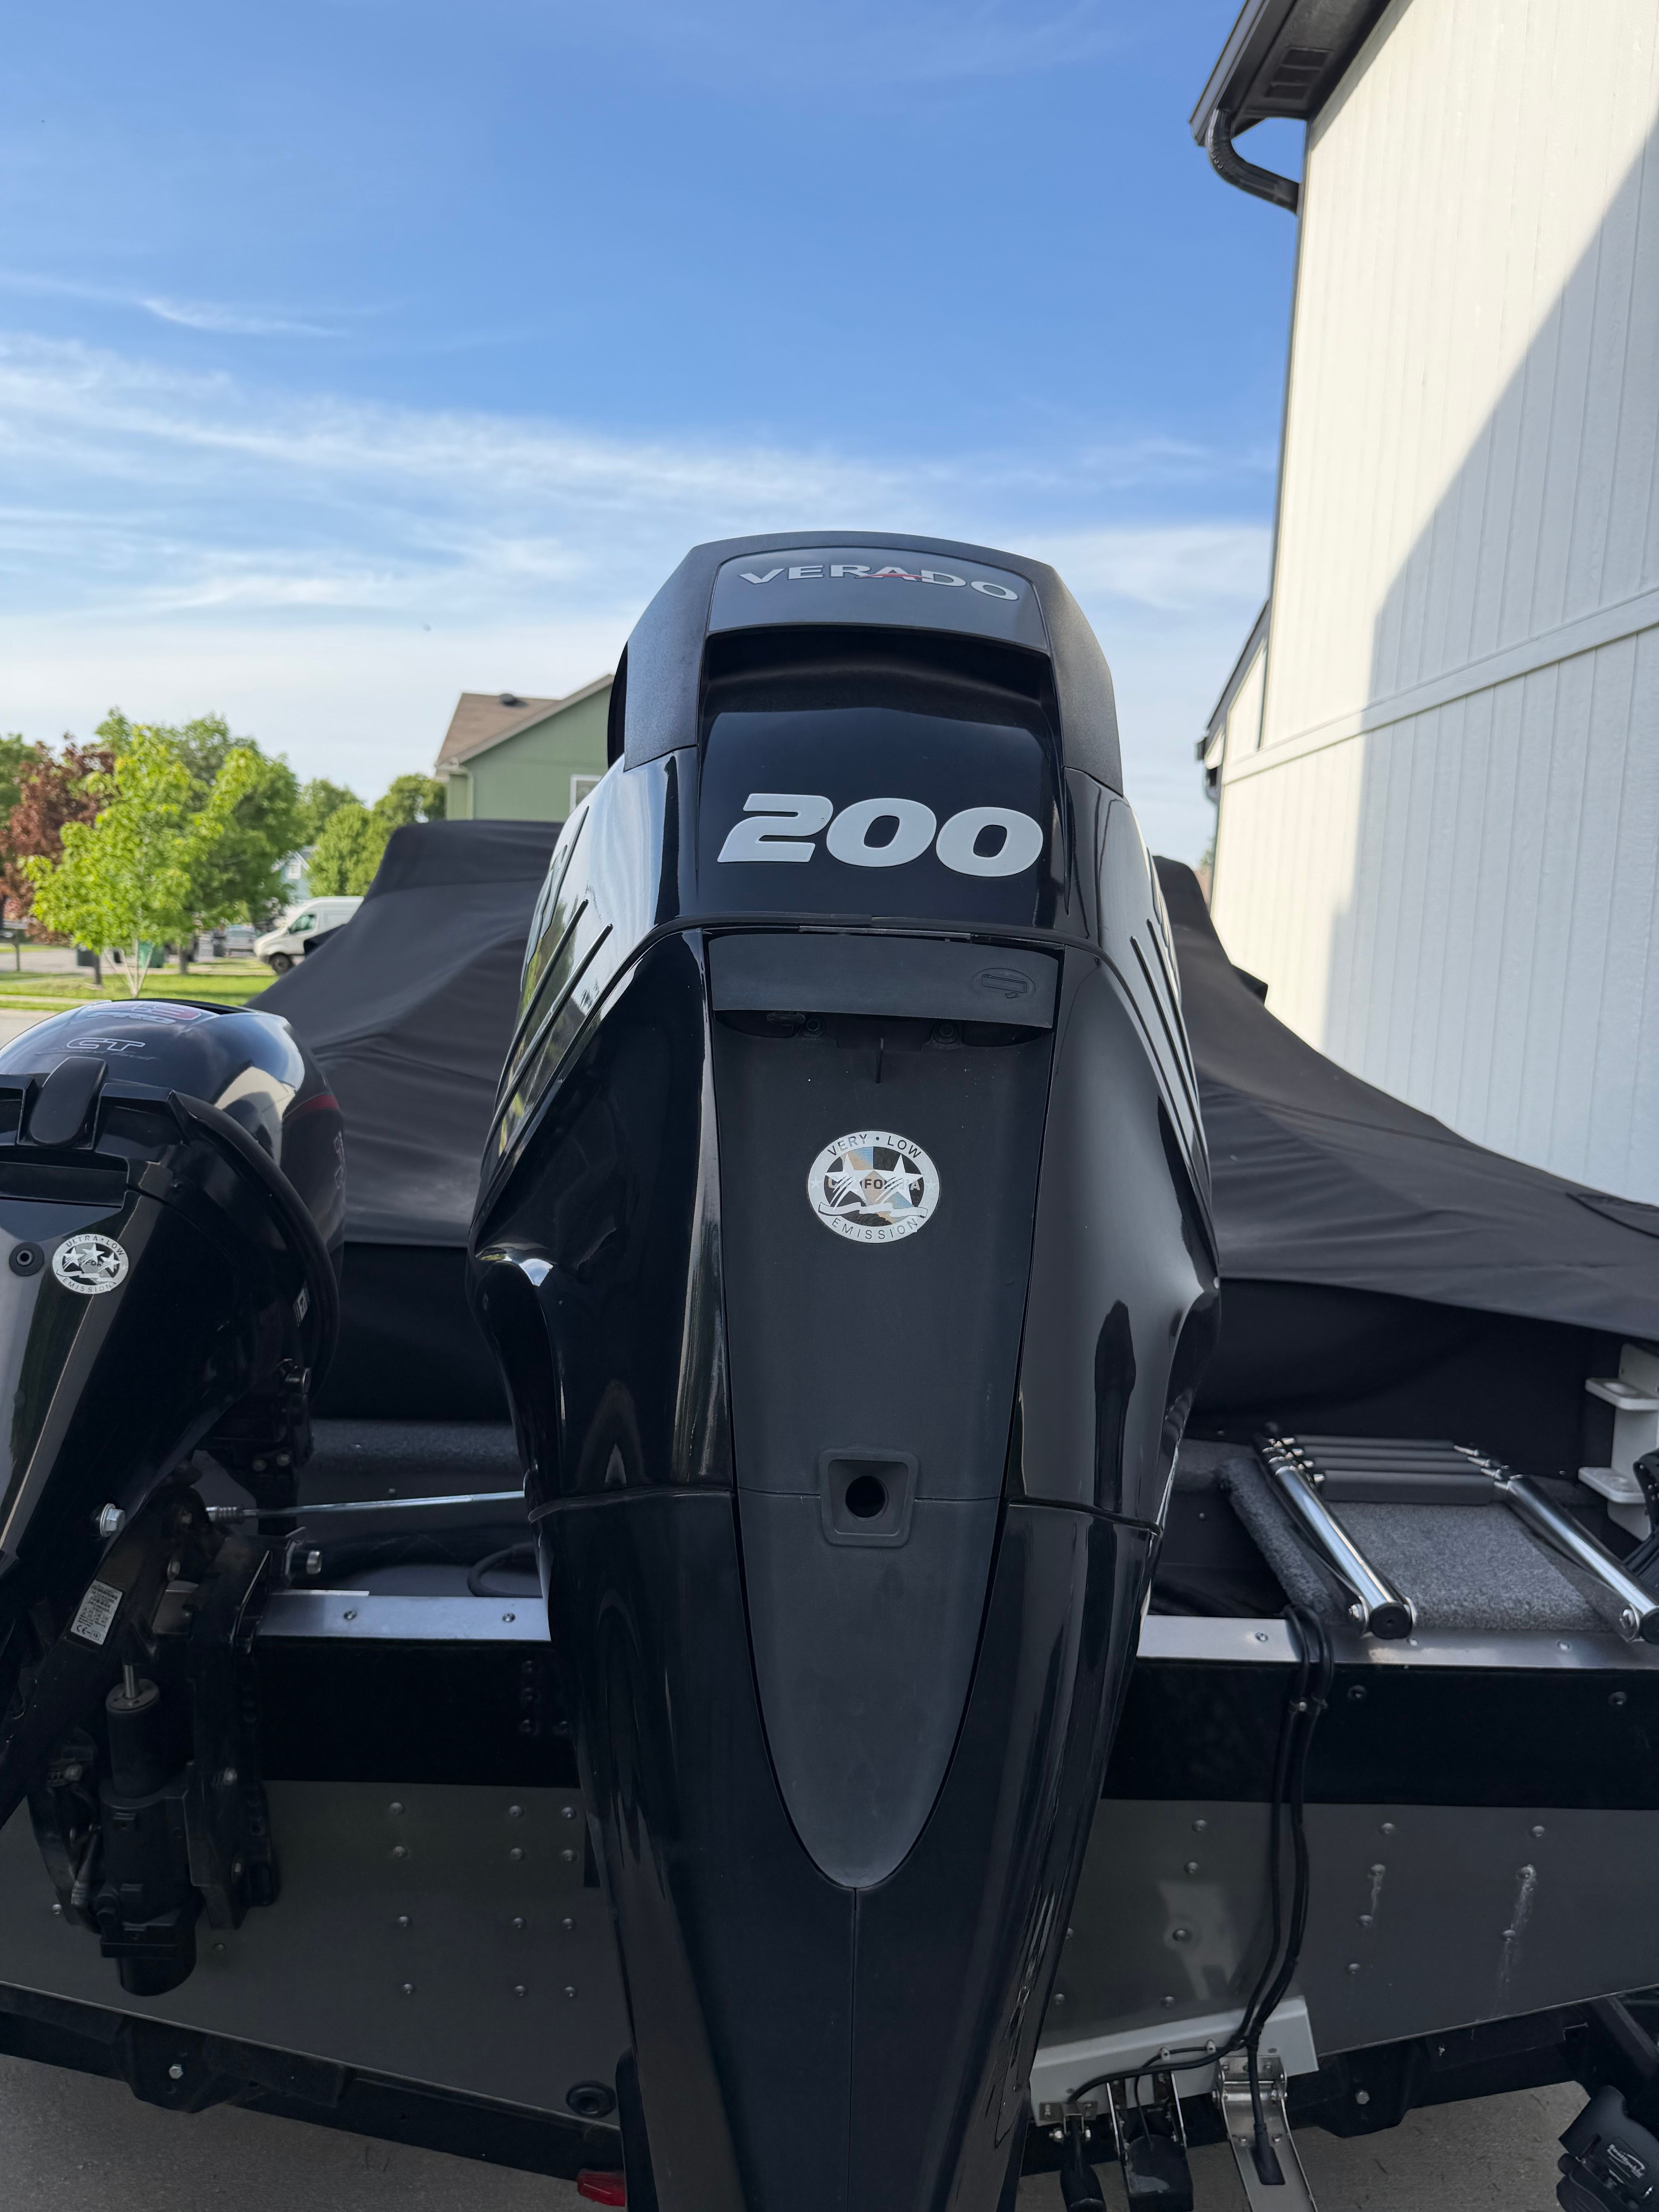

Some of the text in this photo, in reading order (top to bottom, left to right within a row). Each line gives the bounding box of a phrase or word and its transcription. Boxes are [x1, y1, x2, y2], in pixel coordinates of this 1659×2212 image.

[738, 564, 1019, 601] VERADO
[717, 793, 1043, 877] 200
[827, 1133, 921, 1158] VERY LOW
[831, 1217, 918, 1240] EMISSION
[66, 1235, 124, 1255] ULTRA LOW
[62, 1277, 112, 1293] EMISSION
